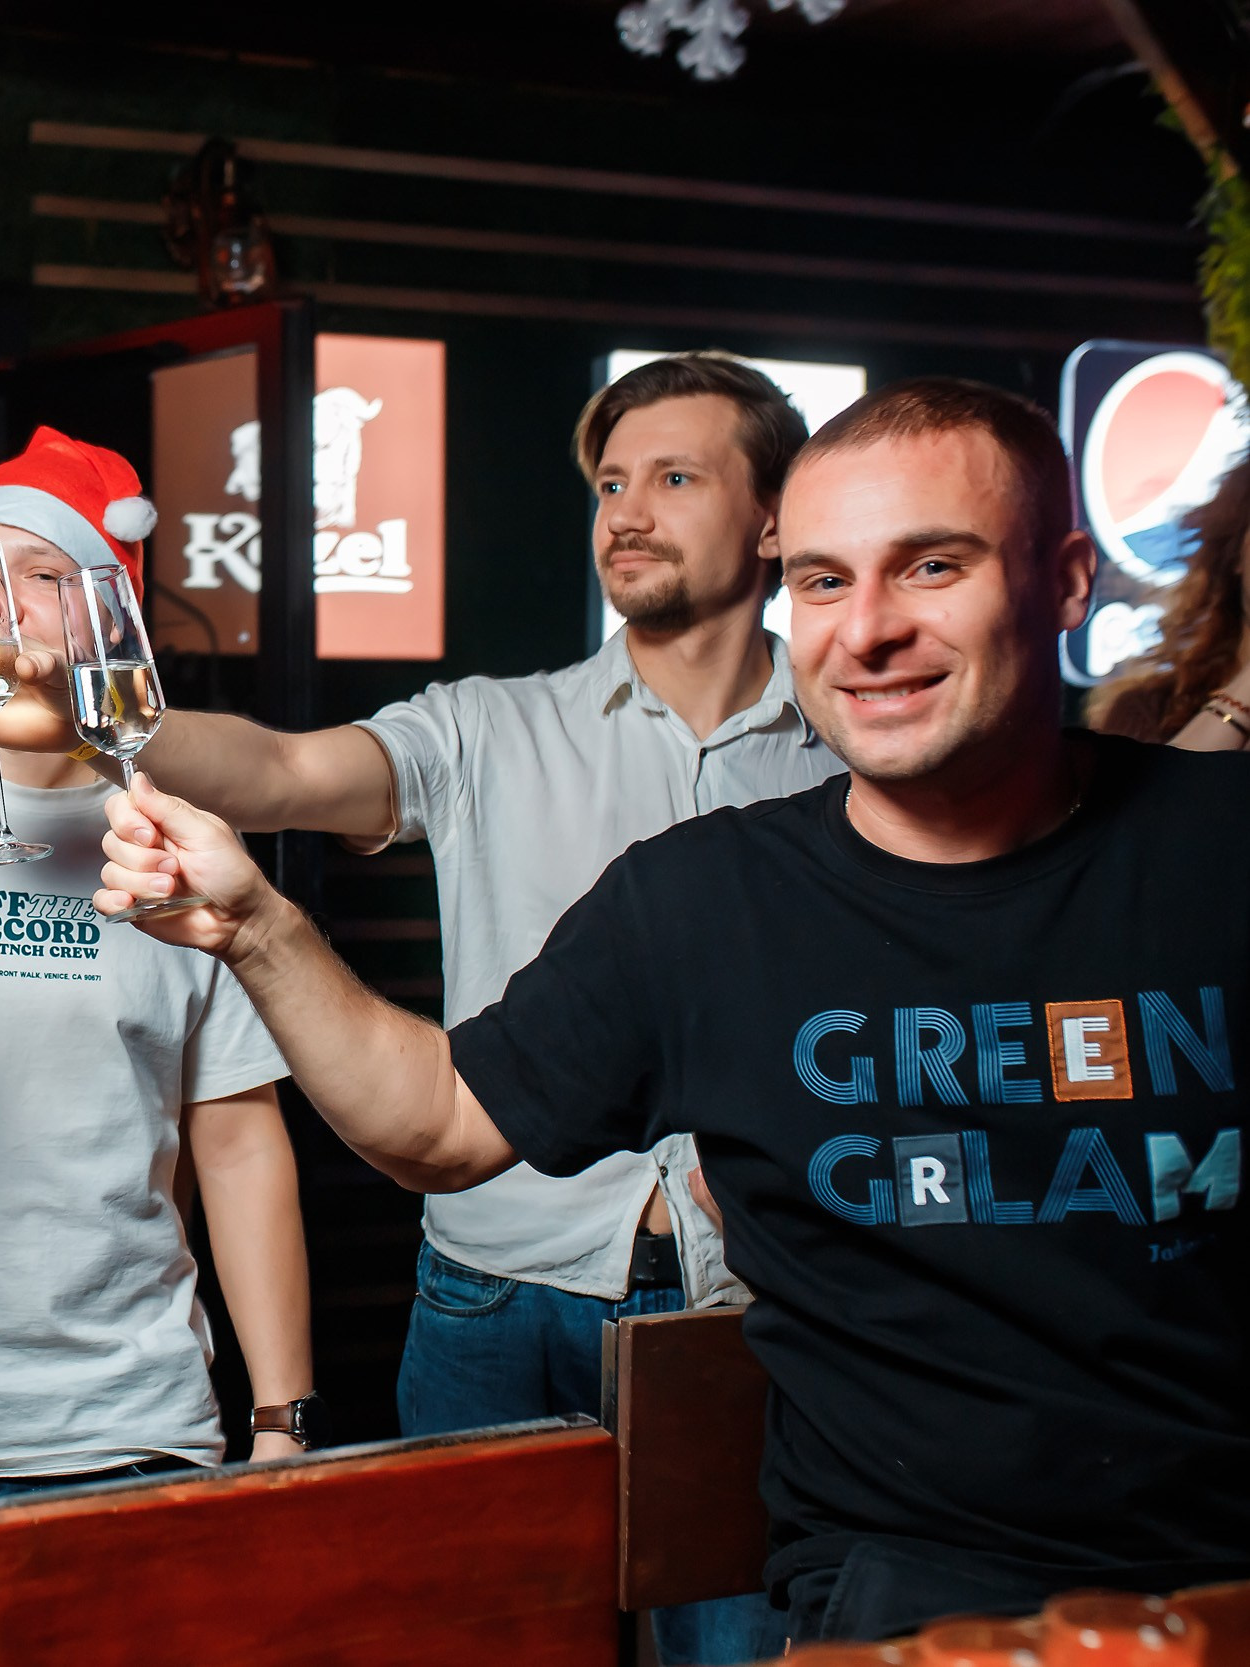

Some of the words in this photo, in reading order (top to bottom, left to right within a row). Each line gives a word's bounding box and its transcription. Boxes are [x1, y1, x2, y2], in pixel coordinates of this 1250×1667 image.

[27, 893, 97, 922] THE
[49, 945, 99, 960] CREW
[71, 973, 82, 981] CA
[792, 986, 1236, 1106] GREEN
